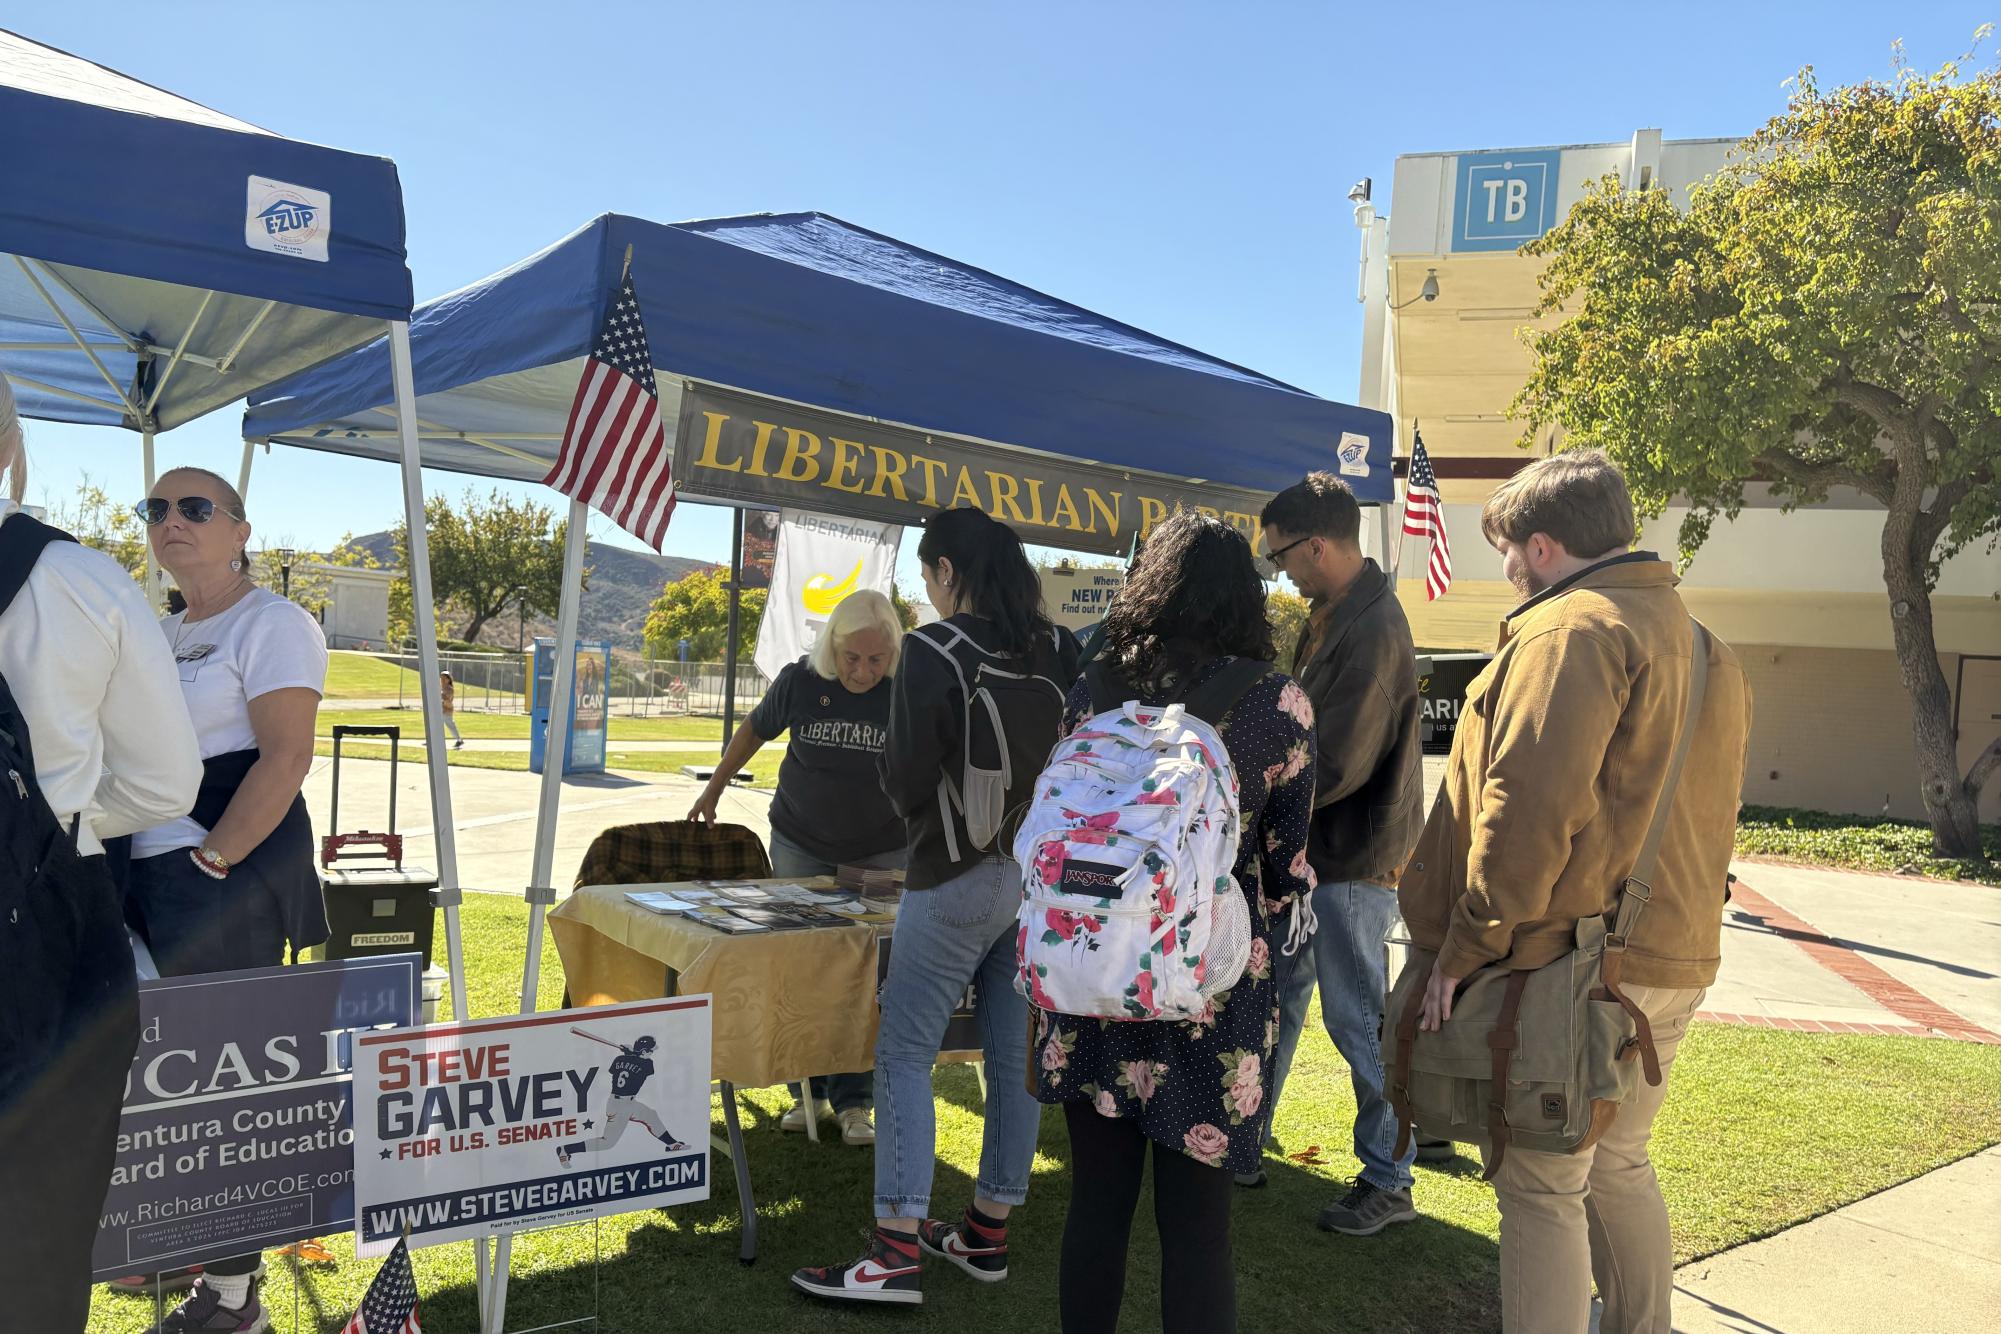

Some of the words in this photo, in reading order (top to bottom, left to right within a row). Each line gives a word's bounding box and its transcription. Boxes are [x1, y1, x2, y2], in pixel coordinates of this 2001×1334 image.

[1483, 179, 1528, 223] TB
[694, 411, 1122, 537] LIBERTARIAN
[795, 514, 887, 546] LIBERTARIAN
[1072, 589, 1102, 602] NEW
[1093, 576, 1119, 586] Where
[1062, 604, 1079, 613] Find
[1081, 605, 1095, 613] out
[577, 694, 581, 708] I
[582, 694, 604, 709] CAN
[1420, 699, 1459, 719] ARI
[800, 722, 886, 747] LIBERTARIA
[353, 934, 410, 945] FREEDOM
[378, 1043, 510, 1092] STEVE
[617, 1071, 629, 1088] 6
[377, 1066, 600, 1141] GARVEY
[116, 1118, 223, 1153] entura
[233, 1098, 347, 1133] County
[399, 1140, 441, 1160] FOR
[450, 1131, 490, 1152] U.S.
[497, 1118, 577, 1146] SENATE
[110, 1153, 165, 1186] ard
[175, 1146, 210, 1174] of
[219, 1126, 355, 1167] Educatio
[370, 1160, 699, 1235] WWW.STEVEGARVEY.COM
